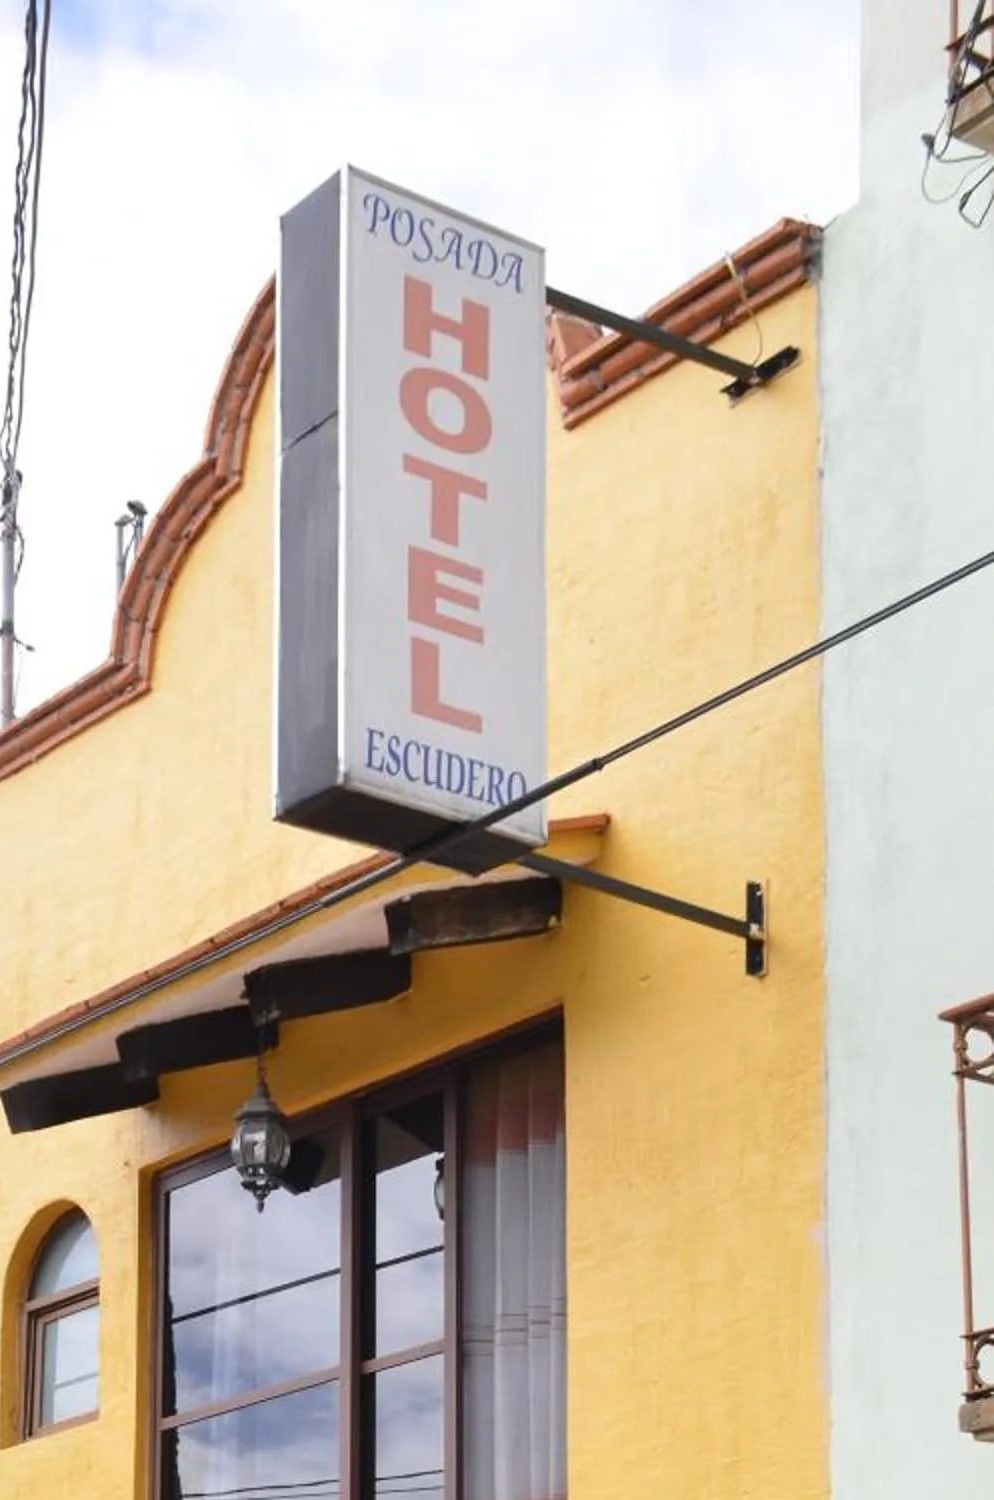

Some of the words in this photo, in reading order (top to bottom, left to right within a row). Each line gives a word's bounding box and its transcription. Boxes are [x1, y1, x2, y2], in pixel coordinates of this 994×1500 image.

[363, 193, 524, 294] POSADA
[398, 273, 493, 735] HOTEL
[365, 727, 528, 807] ESCUDERO
